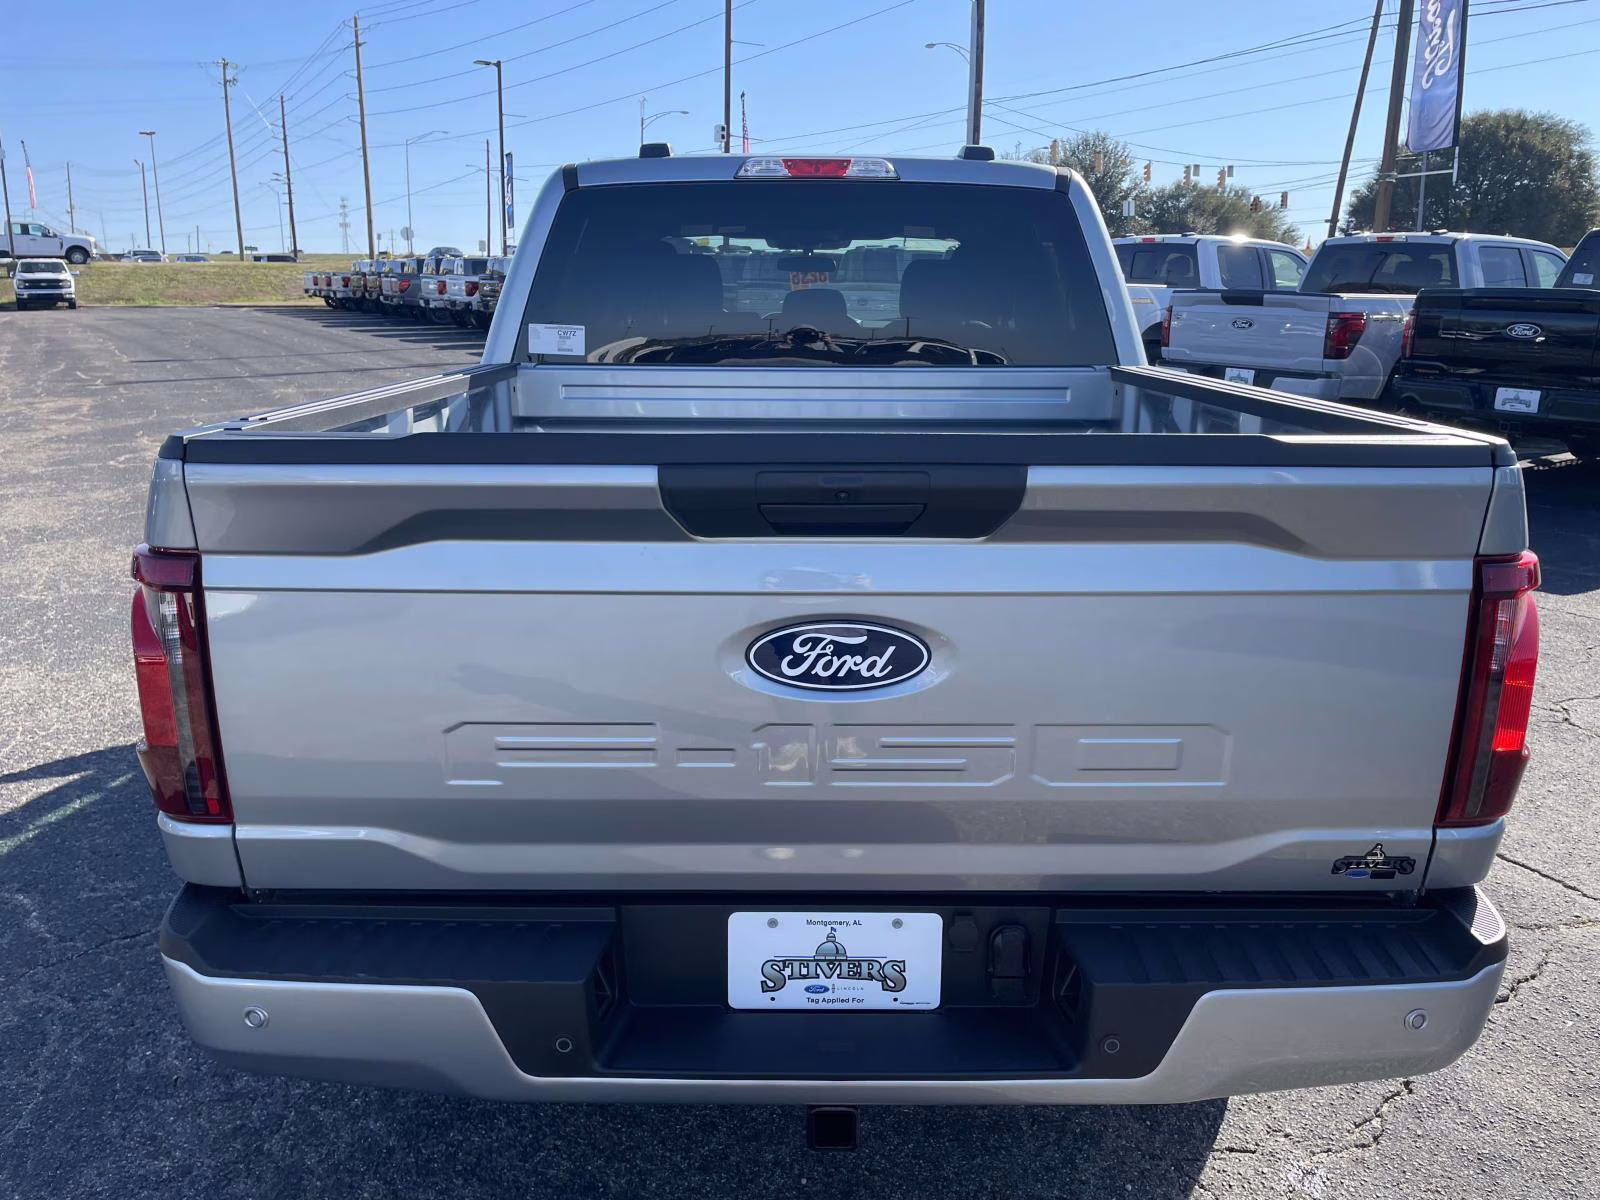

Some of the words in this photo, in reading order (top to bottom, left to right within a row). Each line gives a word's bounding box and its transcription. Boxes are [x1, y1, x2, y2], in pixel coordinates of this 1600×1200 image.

[1512, 325, 1535, 336] Ford
[781, 633, 896, 677] Ford
[443, 721, 1232, 788] F-150
[806, 919, 851, 928] Montgomery,
[761, 959, 907, 993] STIVERS
